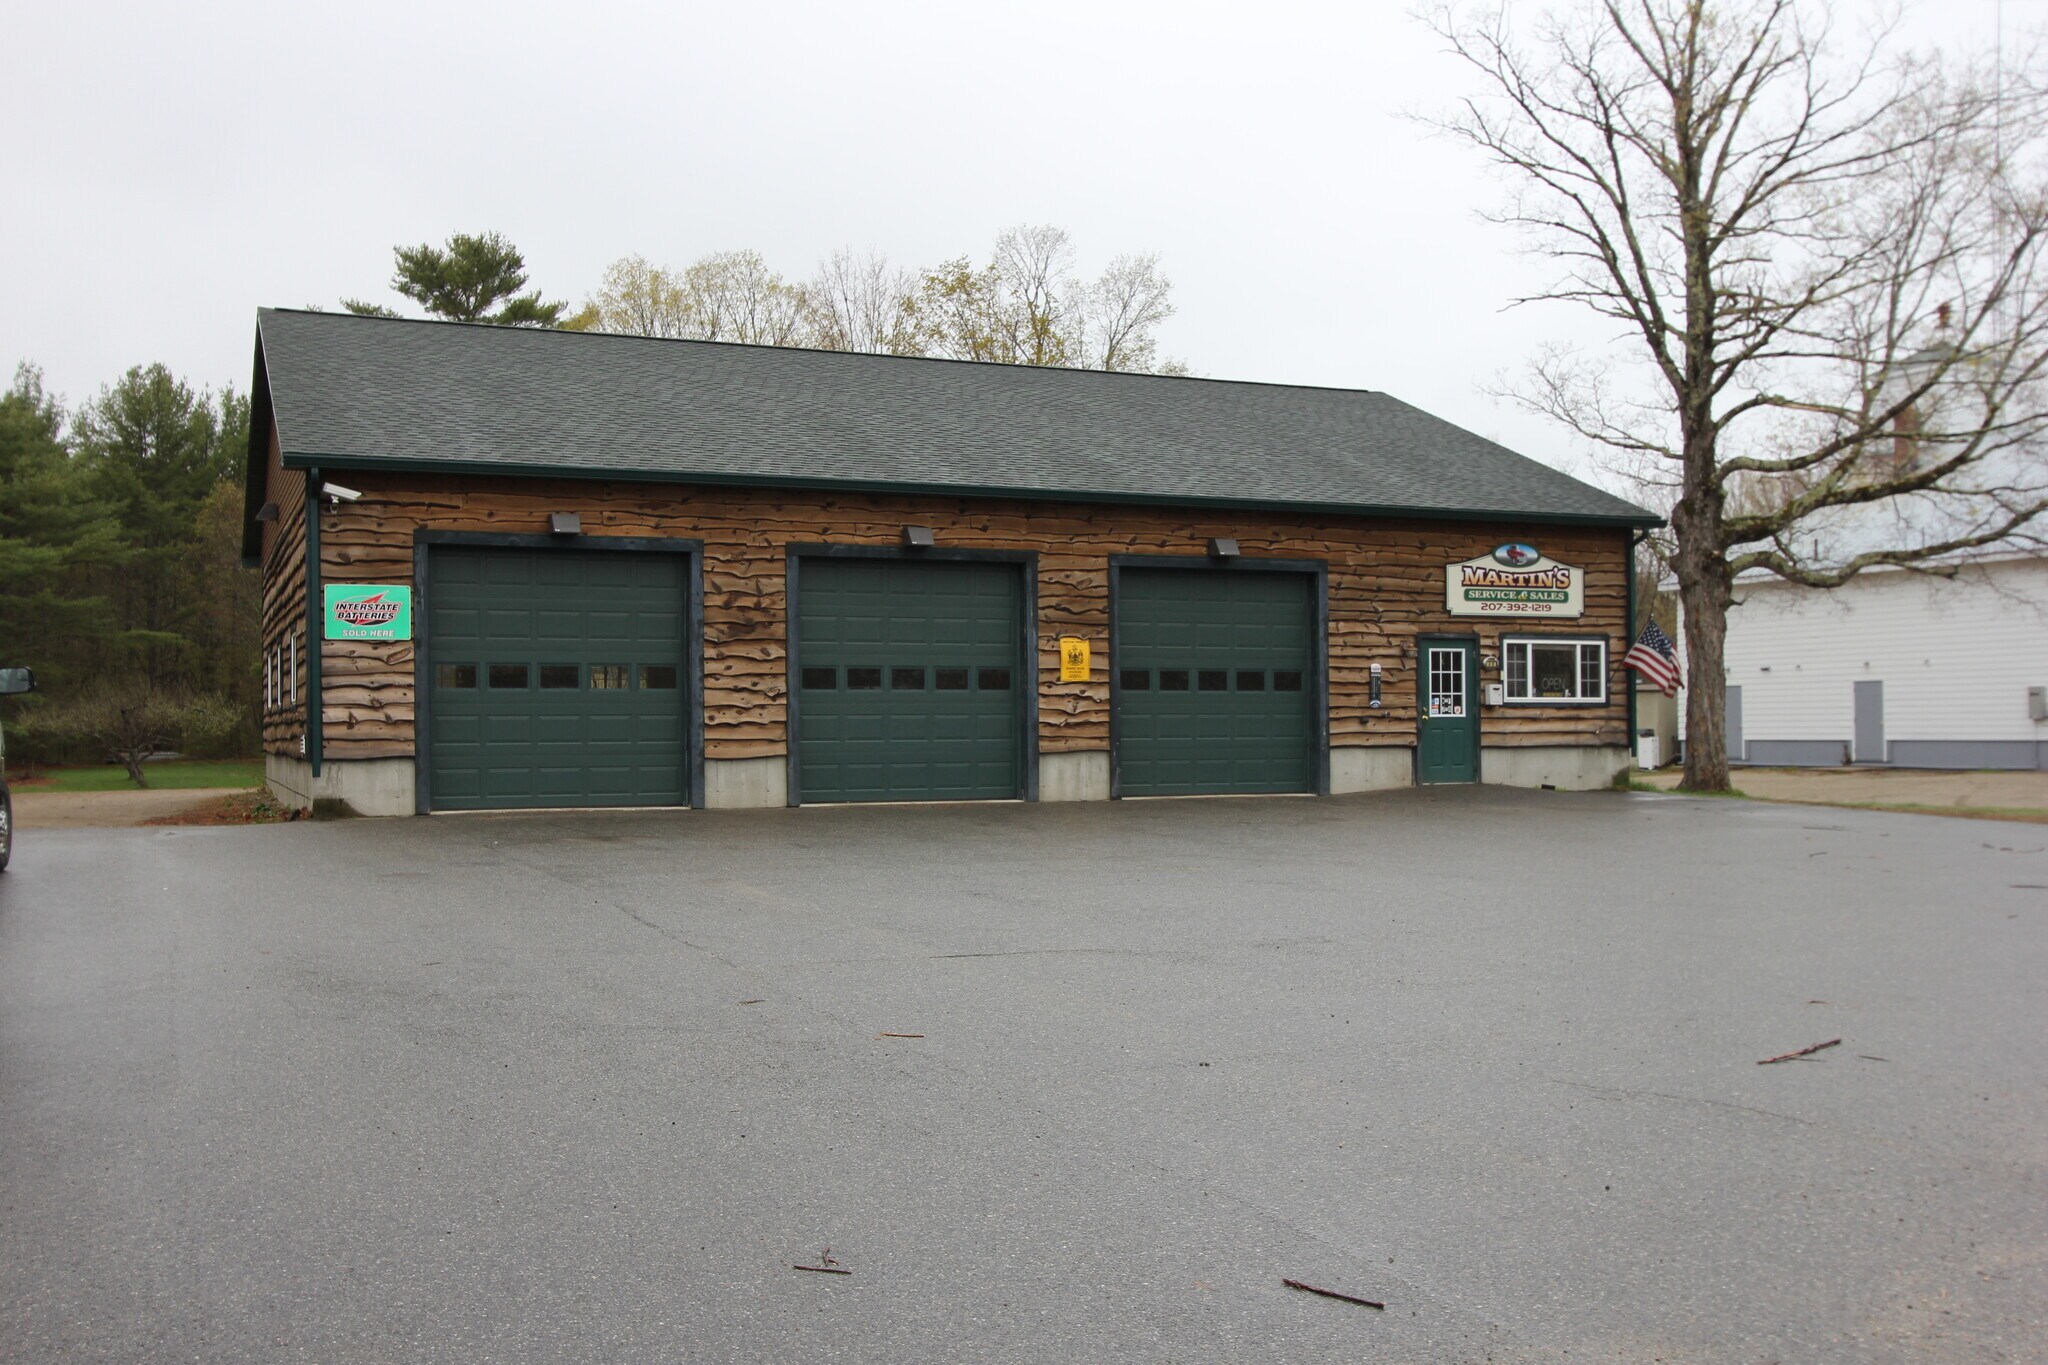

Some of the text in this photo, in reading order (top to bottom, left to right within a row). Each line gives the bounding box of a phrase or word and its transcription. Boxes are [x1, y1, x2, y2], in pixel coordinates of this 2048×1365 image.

[1462, 566, 1570, 589] MARTIN'S
[1468, 591, 1565, 600] SERVICE & SALES
[335, 603, 399, 611] INTERSTATE
[1481, 603, 1552, 612] 207-392-1219
[337, 612, 394, 620] BATTERIES
[1541, 677, 1566, 690] OPEN
